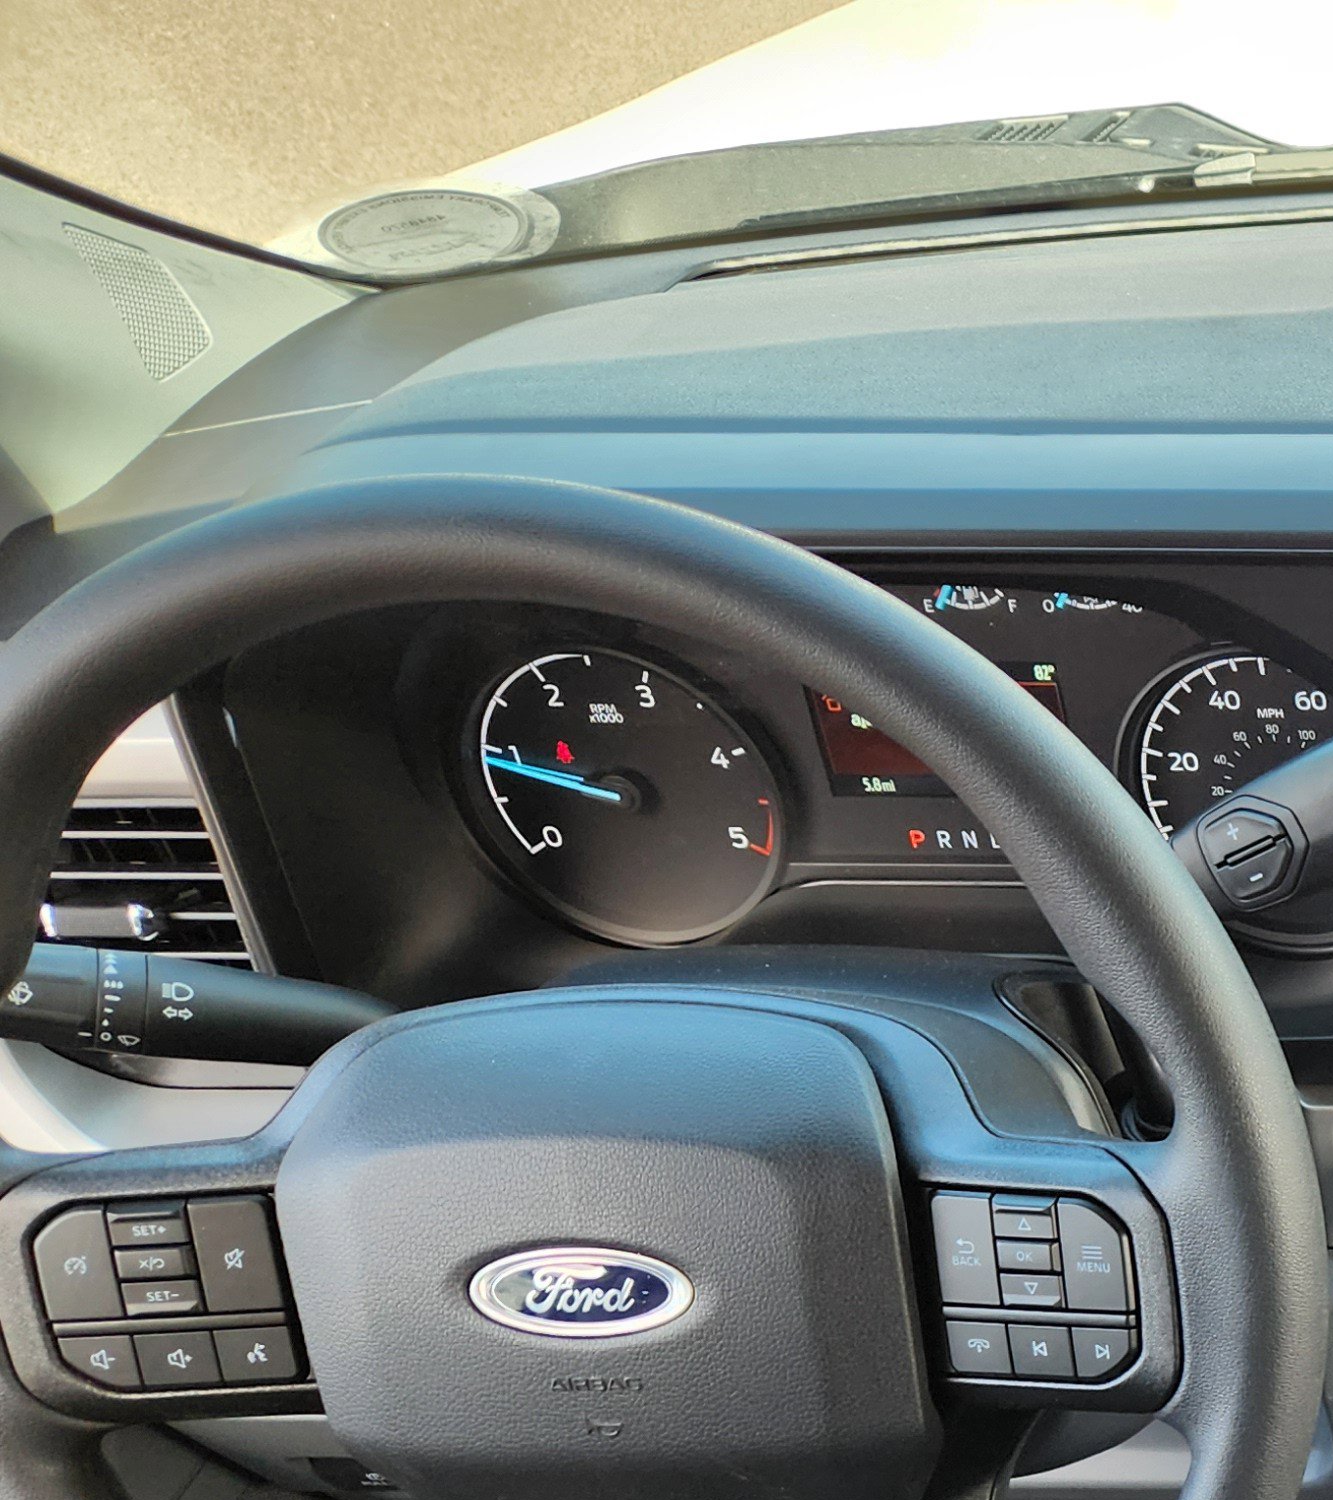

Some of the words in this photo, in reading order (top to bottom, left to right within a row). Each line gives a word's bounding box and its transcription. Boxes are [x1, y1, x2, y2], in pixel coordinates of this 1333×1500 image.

[923, 598, 934, 613] E
[1007, 598, 1017, 614] F
[542, 684, 565, 707] 2
[635, 684, 655, 708] 3
[1208, 690, 1241, 711] 40
[1294, 690, 1327, 711] 60
[589, 703, 617, 714] RPM
[1256, 707, 1285, 719] MPH
[1232, 730, 1247, 742] 60
[1265, 723, 1279, 735] 80
[1297, 729, 1316, 741] 100
[710, 747, 730, 769] 4
[1167, 752, 1199, 772] 20
[1213, 754, 1227, 766] 40
[1211, 785, 1225, 798] 20
[542, 825, 563, 848] 0
[728, 827, 749, 849] 5
[909, 829, 926, 849] P
[935, 829, 953, 849] R
[960, 829, 979, 849] N
[952, 1255, 982, 1267] BACK
[1016, 1252, 1033, 1262] OK
[1076, 1261, 1111, 1274] MENU
[525, 1263, 636, 1314] Ford
[551, 1376, 644, 1392] AIRBAG
